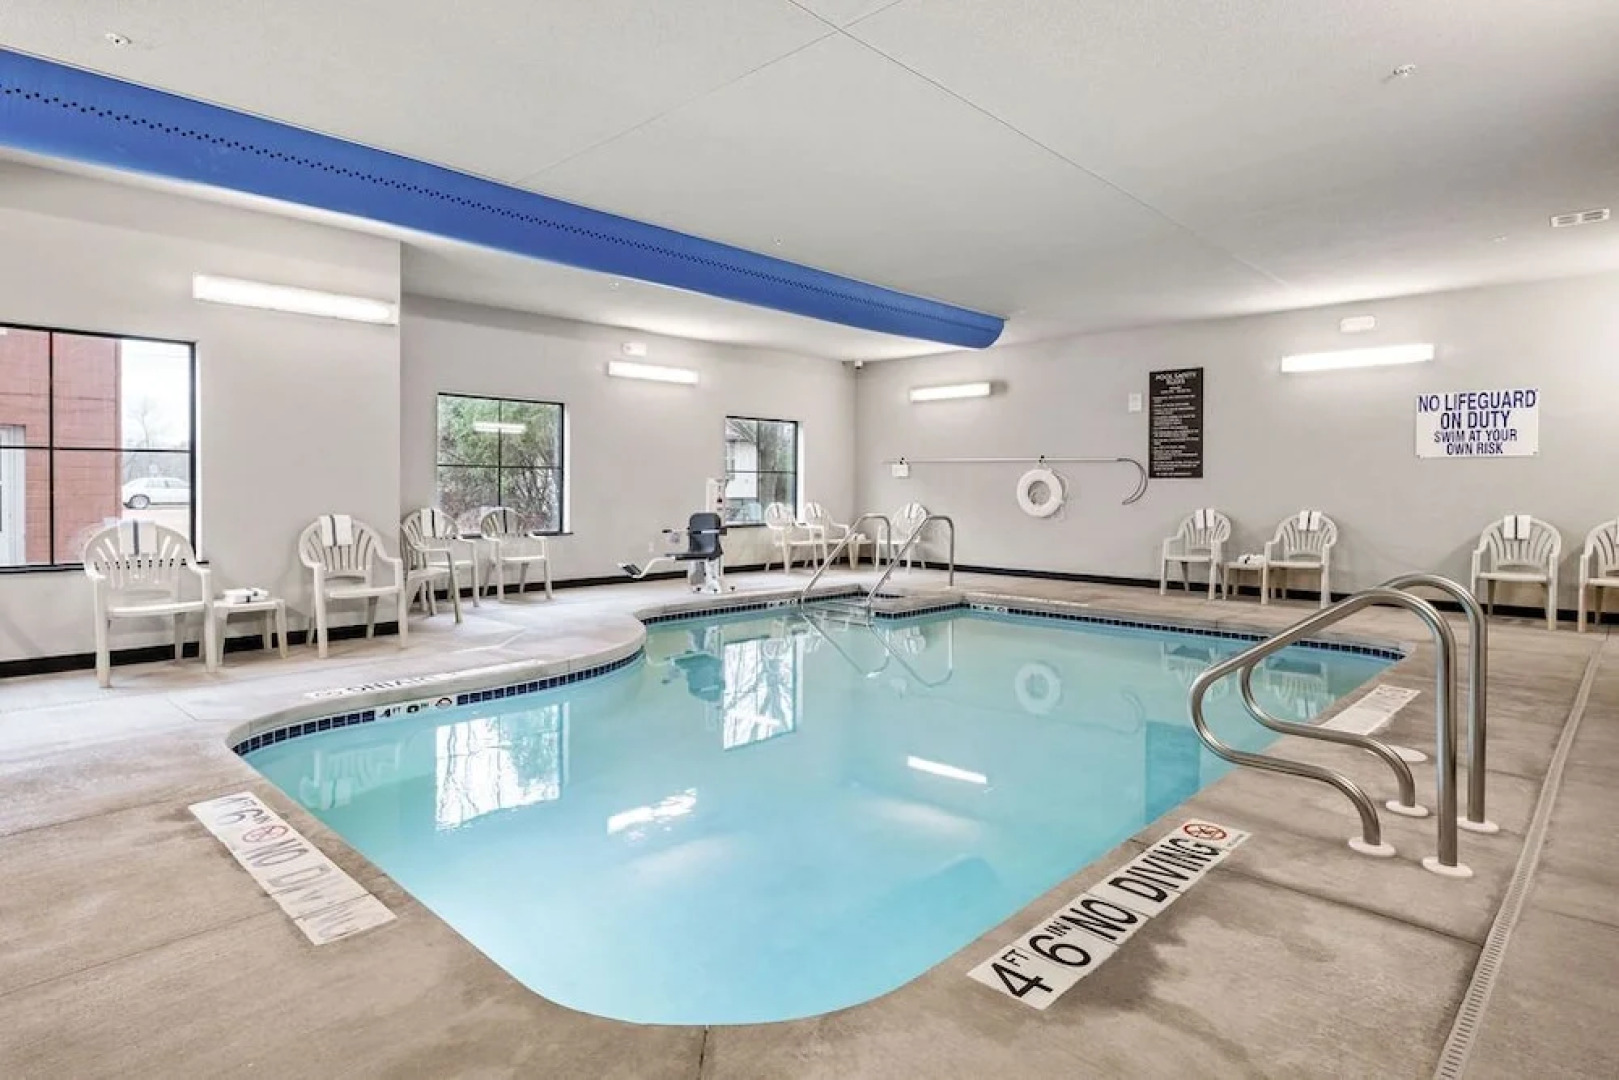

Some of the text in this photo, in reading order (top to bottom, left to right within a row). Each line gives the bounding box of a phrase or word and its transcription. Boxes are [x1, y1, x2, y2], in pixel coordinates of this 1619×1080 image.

[1418, 390, 1536, 412] NO LIFEGUARD
[1440, 411, 1510, 429] ON DUTY
[1434, 429, 1517, 442] SWIM AT YOUR
[1446, 442, 1503, 455] OWN RISK
[242, 838, 310, 869] NO
[1060, 899, 1138, 940] NO
[1108, 838, 1220, 903] DIVING
